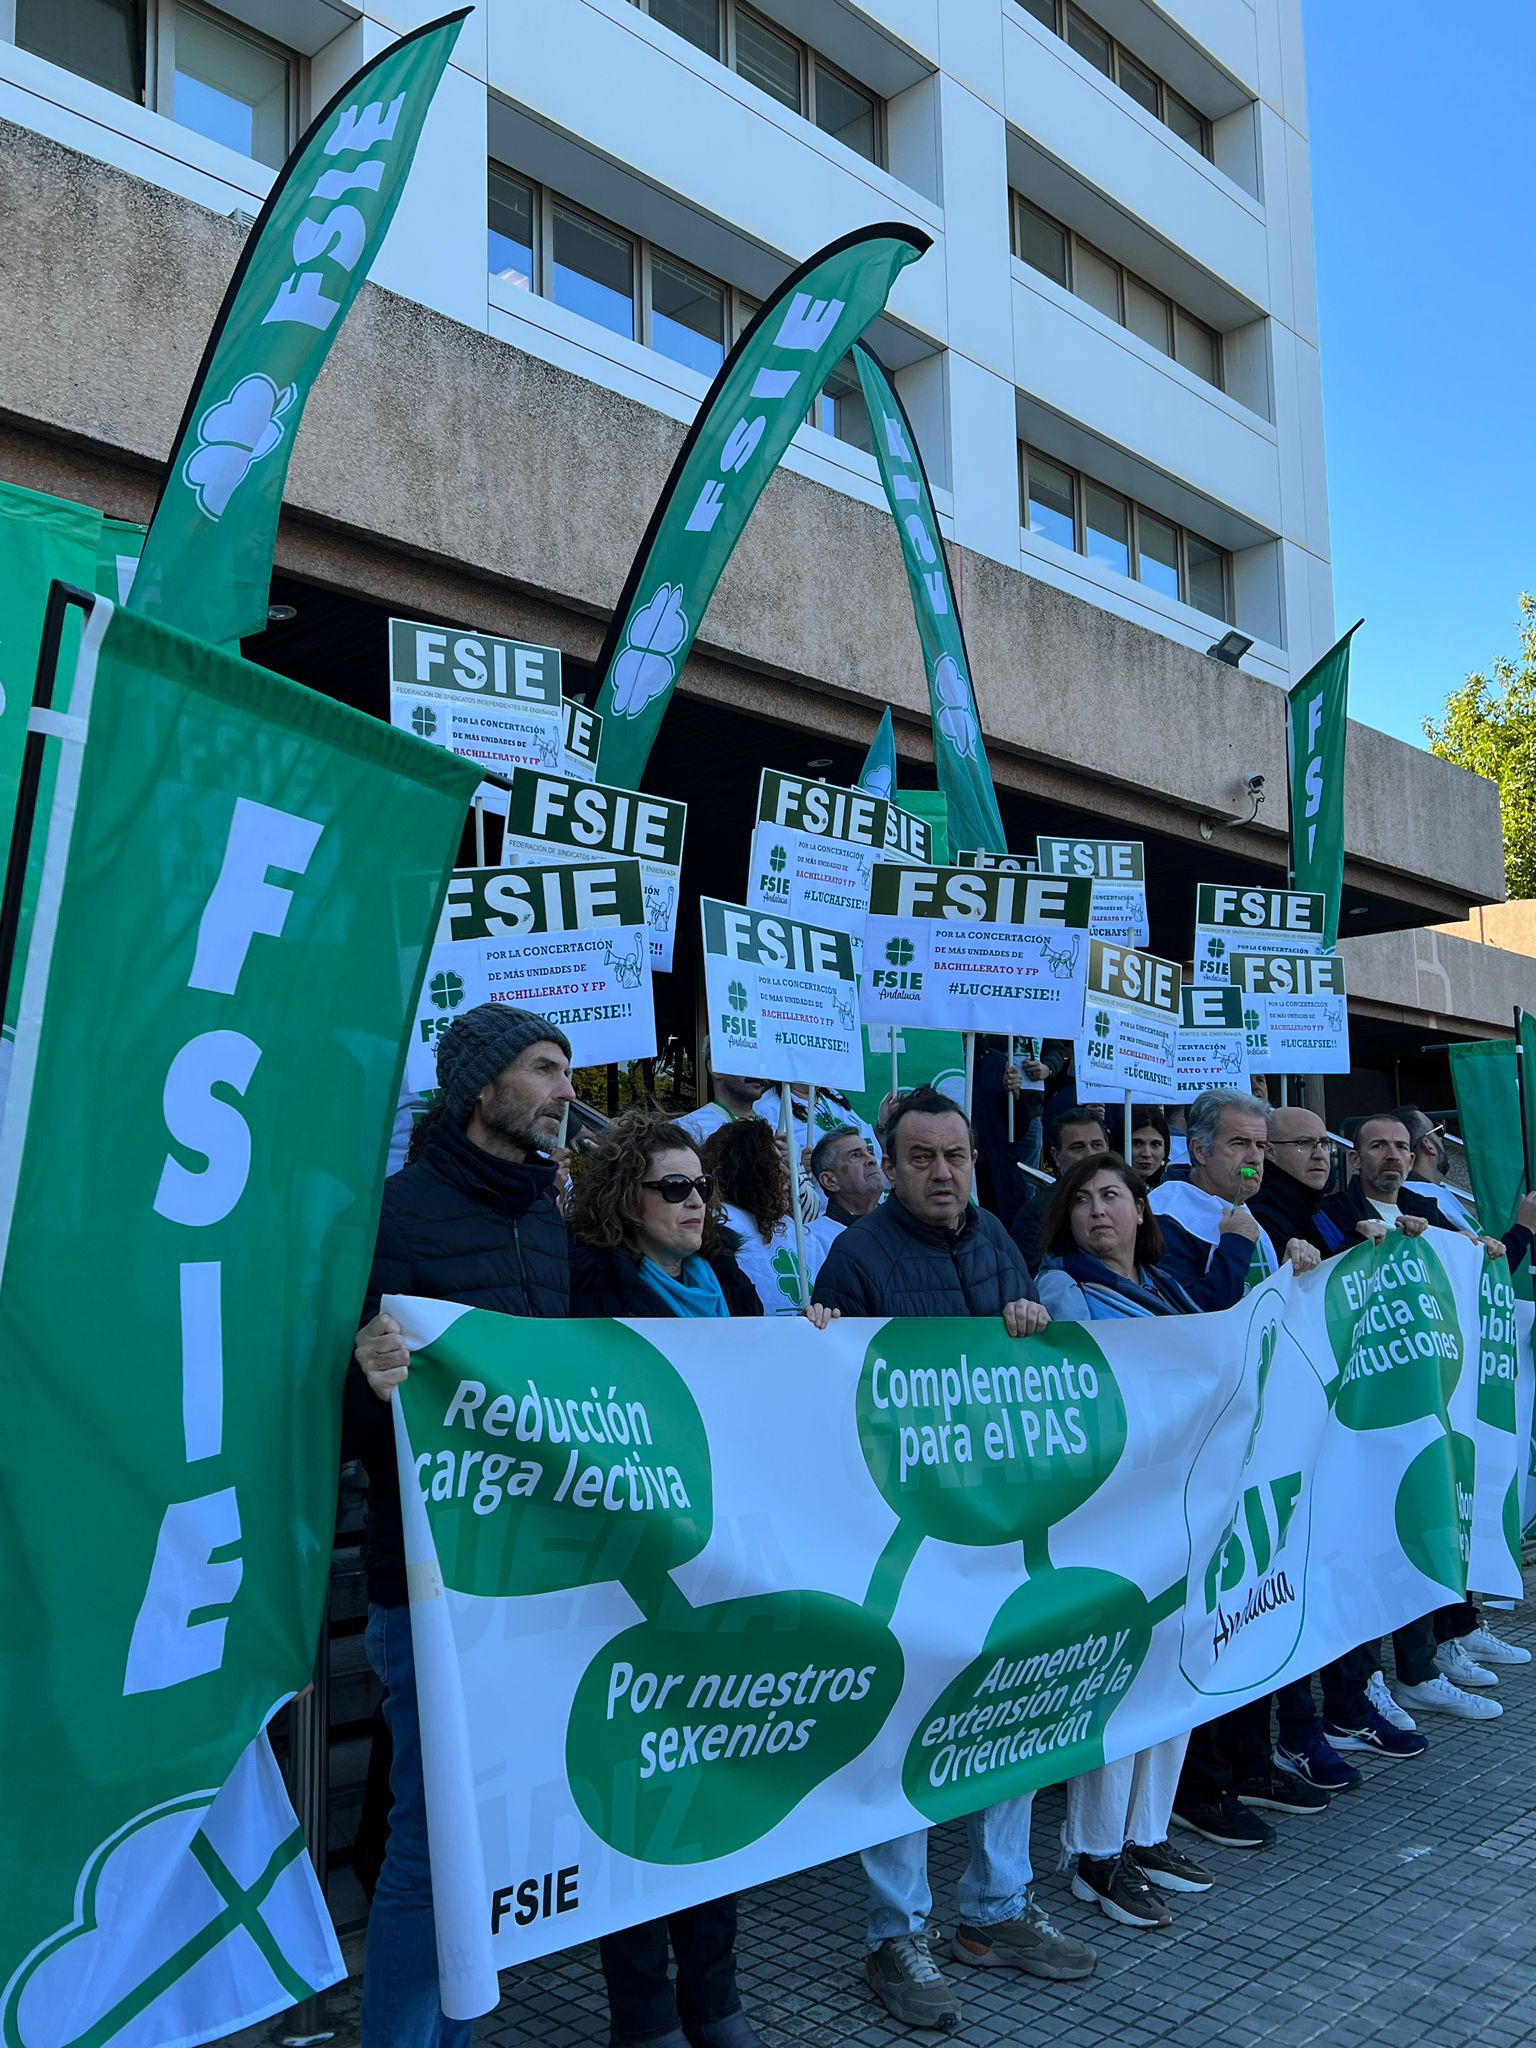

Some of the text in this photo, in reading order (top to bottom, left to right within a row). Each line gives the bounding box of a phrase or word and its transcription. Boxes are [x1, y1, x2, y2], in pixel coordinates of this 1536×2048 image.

[261, 91, 406, 331] FSIE
[685, 291, 845, 532] FSIE
[415, 630, 546, 700] FSIE
[452, 715, 469, 725] POR
[480, 718, 546, 735] CONCERTACIÓN
[563, 703, 593, 757] IE
[464, 732, 480, 741] MÁS
[481, 735, 516, 747] UNIDADES
[517, 740, 527, 748] DE
[453, 747, 541, 766] BACHILLERATO Y FP
[1305, 690, 1323, 864] FSI
[532, 778, 668, 859] FSIE
[775, 779, 875, 845] FSIE
[509, 839, 548, 853] FEDERACIÓN
[548, 847, 557, 855] DE
[557, 849, 591, 861] SINDICATOS
[798, 841, 809, 849] POR
[817, 844, 864, 860] CONCERTACIÓN
[1053, 842, 1133, 878] FSIE
[646, 866, 677, 877] ENSEÑANZA
[804, 856, 816, 865] MÁS
[818, 859, 841, 870] UNIDADES
[760, 874, 790, 895] FSIE
[796, 870, 841, 885] BACHILLERATO
[804, 889, 867, 910] #LUCHAFSIE!!
[898, 871, 1069, 927] FSIE
[1214, 889, 1311, 930] FSIE
[724, 910, 841, 979] FSIE
[936, 930, 1051, 945] POR LA CONCERTACIÓN
[487, 938, 613, 960] POR LA CONCERTACIÓN
[935, 946, 946, 954] DE
[948, 946, 966, 955] MÁS
[968, 949, 1010, 958] UNIDADES
[1258, 945, 1309, 954] CONCERTACIÓN
[488, 963, 587, 981] DE MÁS UNIDADES DE
[934, 962, 1039, 976] BACHILLERATO Y FP
[1100, 947, 1173, 1008] FSIE
[1200, 960, 1229, 975] FSIE
[1244, 956, 1334, 995] FSIE
[759, 976, 837, 995] POR LA CONCERTACIÓN
[872, 970, 923, 990] FSIE
[490, 981, 606, 1002] BACHILLERATO Y FP
[769, 993, 783, 1003] MÁS
[784, 996, 814, 1007] UNIDADES
[949, 982, 1060, 1002] #LUCHAFSIE!!
[722, 1014, 757, 1038] FSIE
[761, 1009, 819, 1024] BACHILLERATO
[826, 1018, 835, 1026] FP
[775, 1032, 850, 1053] #LUCHAFSIE!!
[1088, 1040, 1114, 1060] FSIE
[1246, 1034, 1268, 1047] SIE
[1281, 1039, 1337, 1048] #LUCHAFSIE!!
[122, 797, 325, 1696] FSIE
[1418, 1293, 1443, 1321] en
[872, 1353, 1099, 1421] Complemento
[443, 1379, 653, 1446] Reducción
[900, 1407, 1087, 1483] para el PAS
[414, 1448, 692, 1515] carga lectiva
[973, 1628, 1131, 1697] Aumento y
[605, 1661, 876, 1720] Por nuestros
[922, 1658, 1133, 1747] extensión de la
[639, 1710, 816, 1779] sexenios
[929, 1706, 1093, 1788] Orientación
[492, 1864, 579, 1936] FSIE
